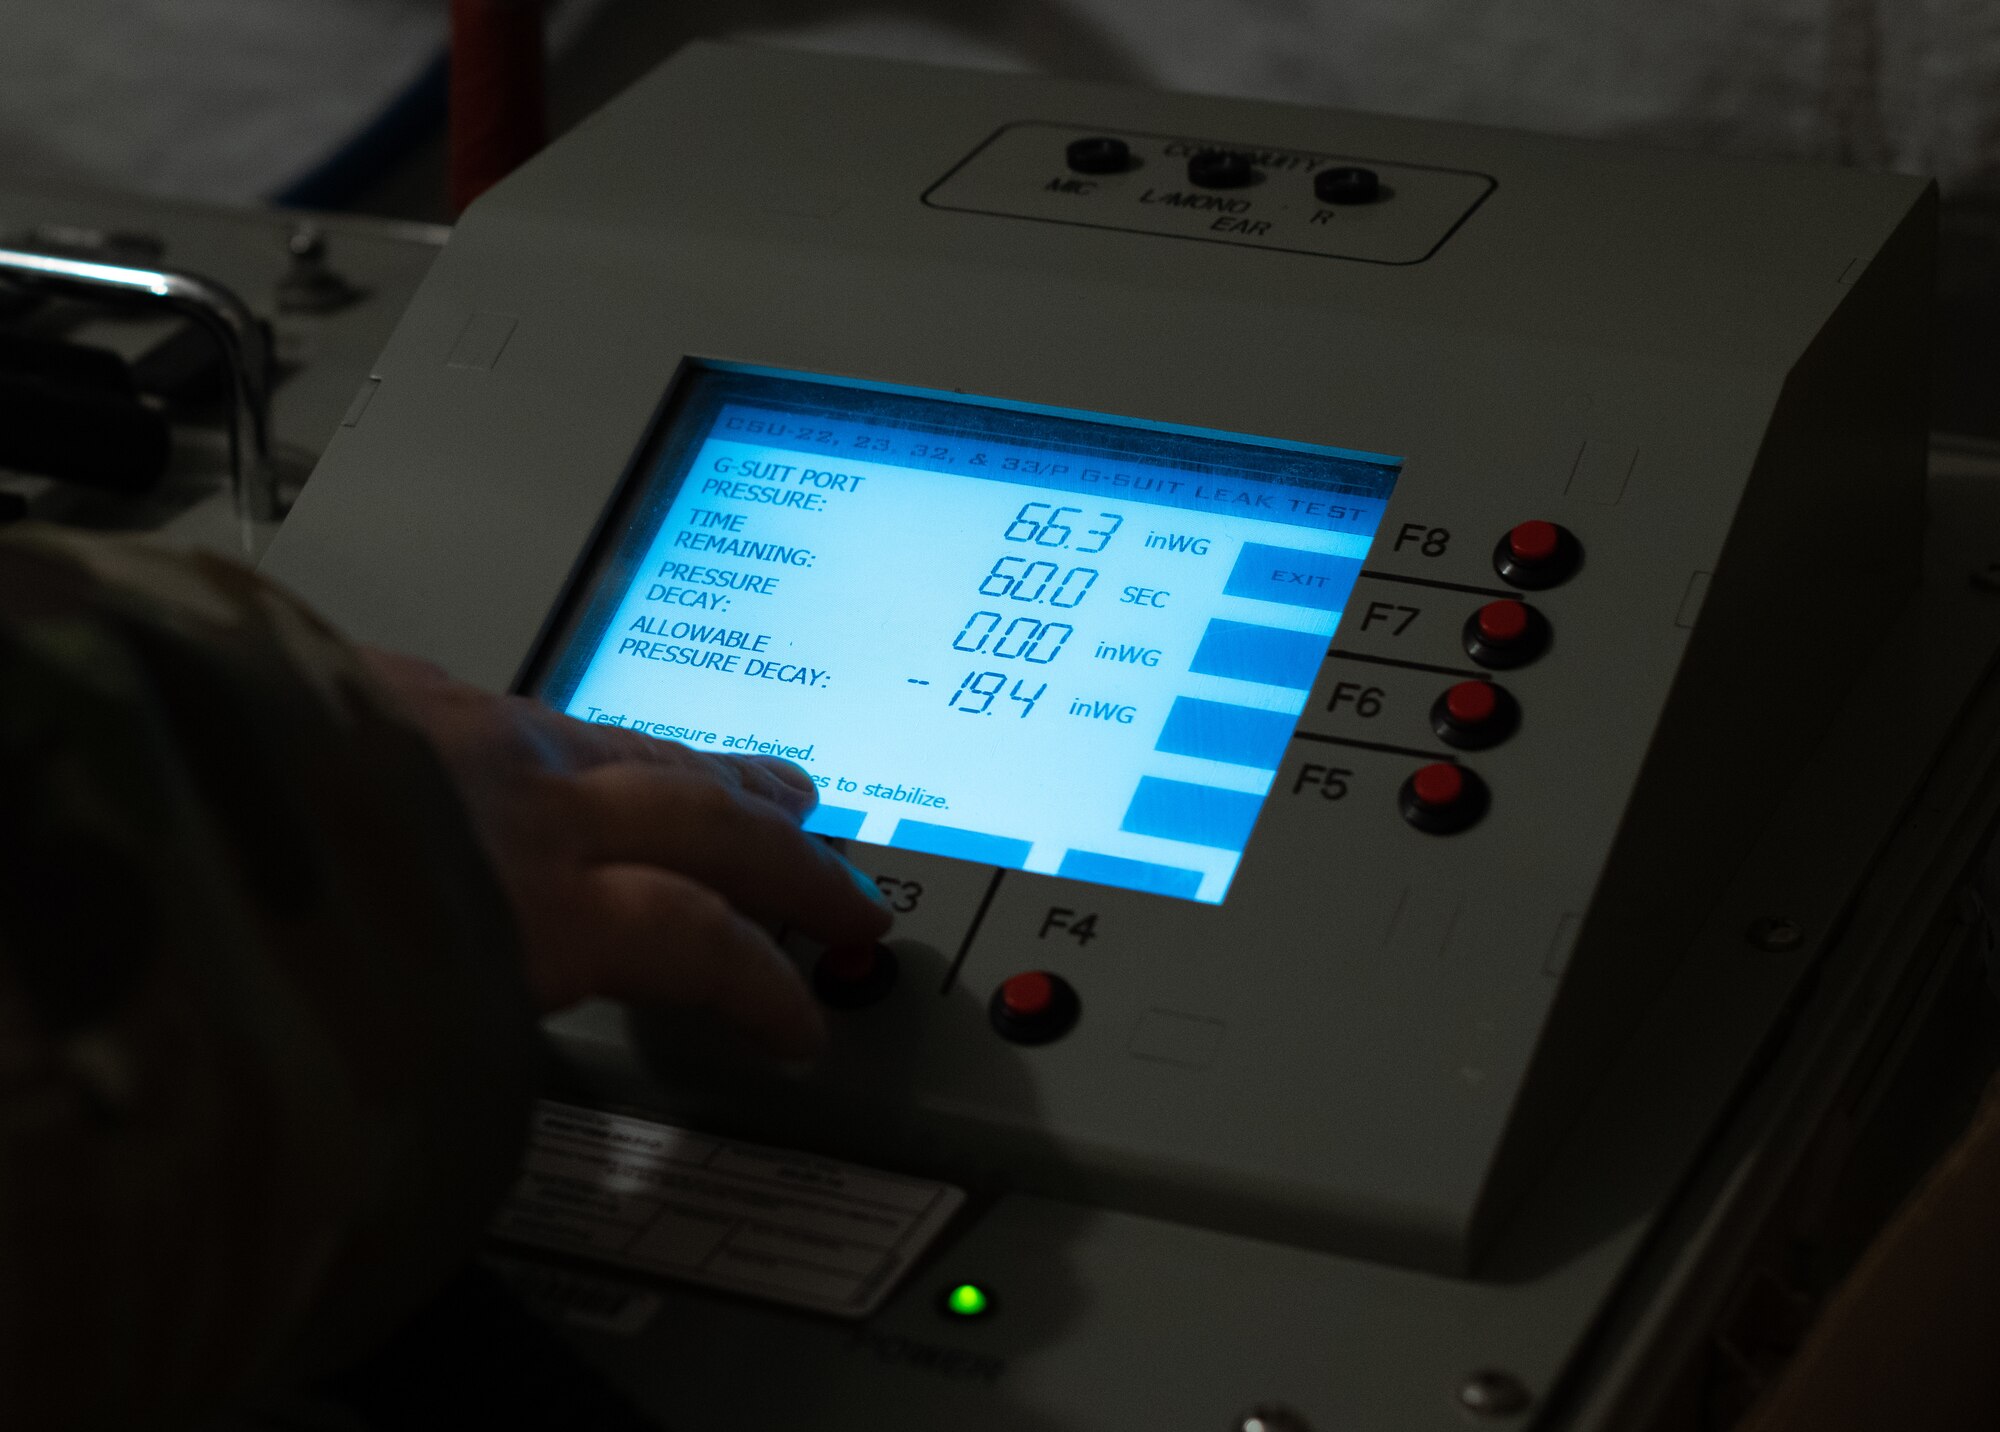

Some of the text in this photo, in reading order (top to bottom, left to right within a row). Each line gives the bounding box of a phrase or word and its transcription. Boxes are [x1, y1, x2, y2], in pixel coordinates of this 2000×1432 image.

[1045, 178, 1097, 196] MIC
[1210, 216, 1272, 236] EAR
[1310, 209, 1334, 225] R
[713, 457, 866, 493] G-SUIT PORT
[968, 453, 988, 467] &
[1002, 457, 1069, 477] 33/P
[1081, 468, 1186, 494] G-SUIT
[1195, 485, 1272, 509] LEAK
[1287, 499, 1369, 522] TEST
[701, 478, 828, 512] PRESSURE:
[688, 508, 748, 533] TIME
[1004, 502, 1211, 556] 66.3 inWG
[673, 530, 817, 568] REMAINING:
[1394, 522, 1450, 557] F8
[658, 561, 780, 595] PRESSURE
[979, 556, 1170, 608] 60.0 SEC
[1270, 569, 1331, 589] EXIT
[645, 583, 731, 612] DECAY:
[629, 615, 772, 653] ALLOWABLE
[1361, 602, 1420, 636] F7
[952, 610, 1162, 667] 0.00 inWG
[618, 637, 832, 688] PRESSURE DECAY:
[1068, 697, 1137, 724] inWG
[1327, 682, 1385, 718] F6
[587, 706, 815, 762] Test pressure acheived.
[836, 776, 858, 792] to
[862, 783, 950, 810] stabilize.
[1292, 763, 1353, 800] F5
[1038, 906, 1098, 946] F4
